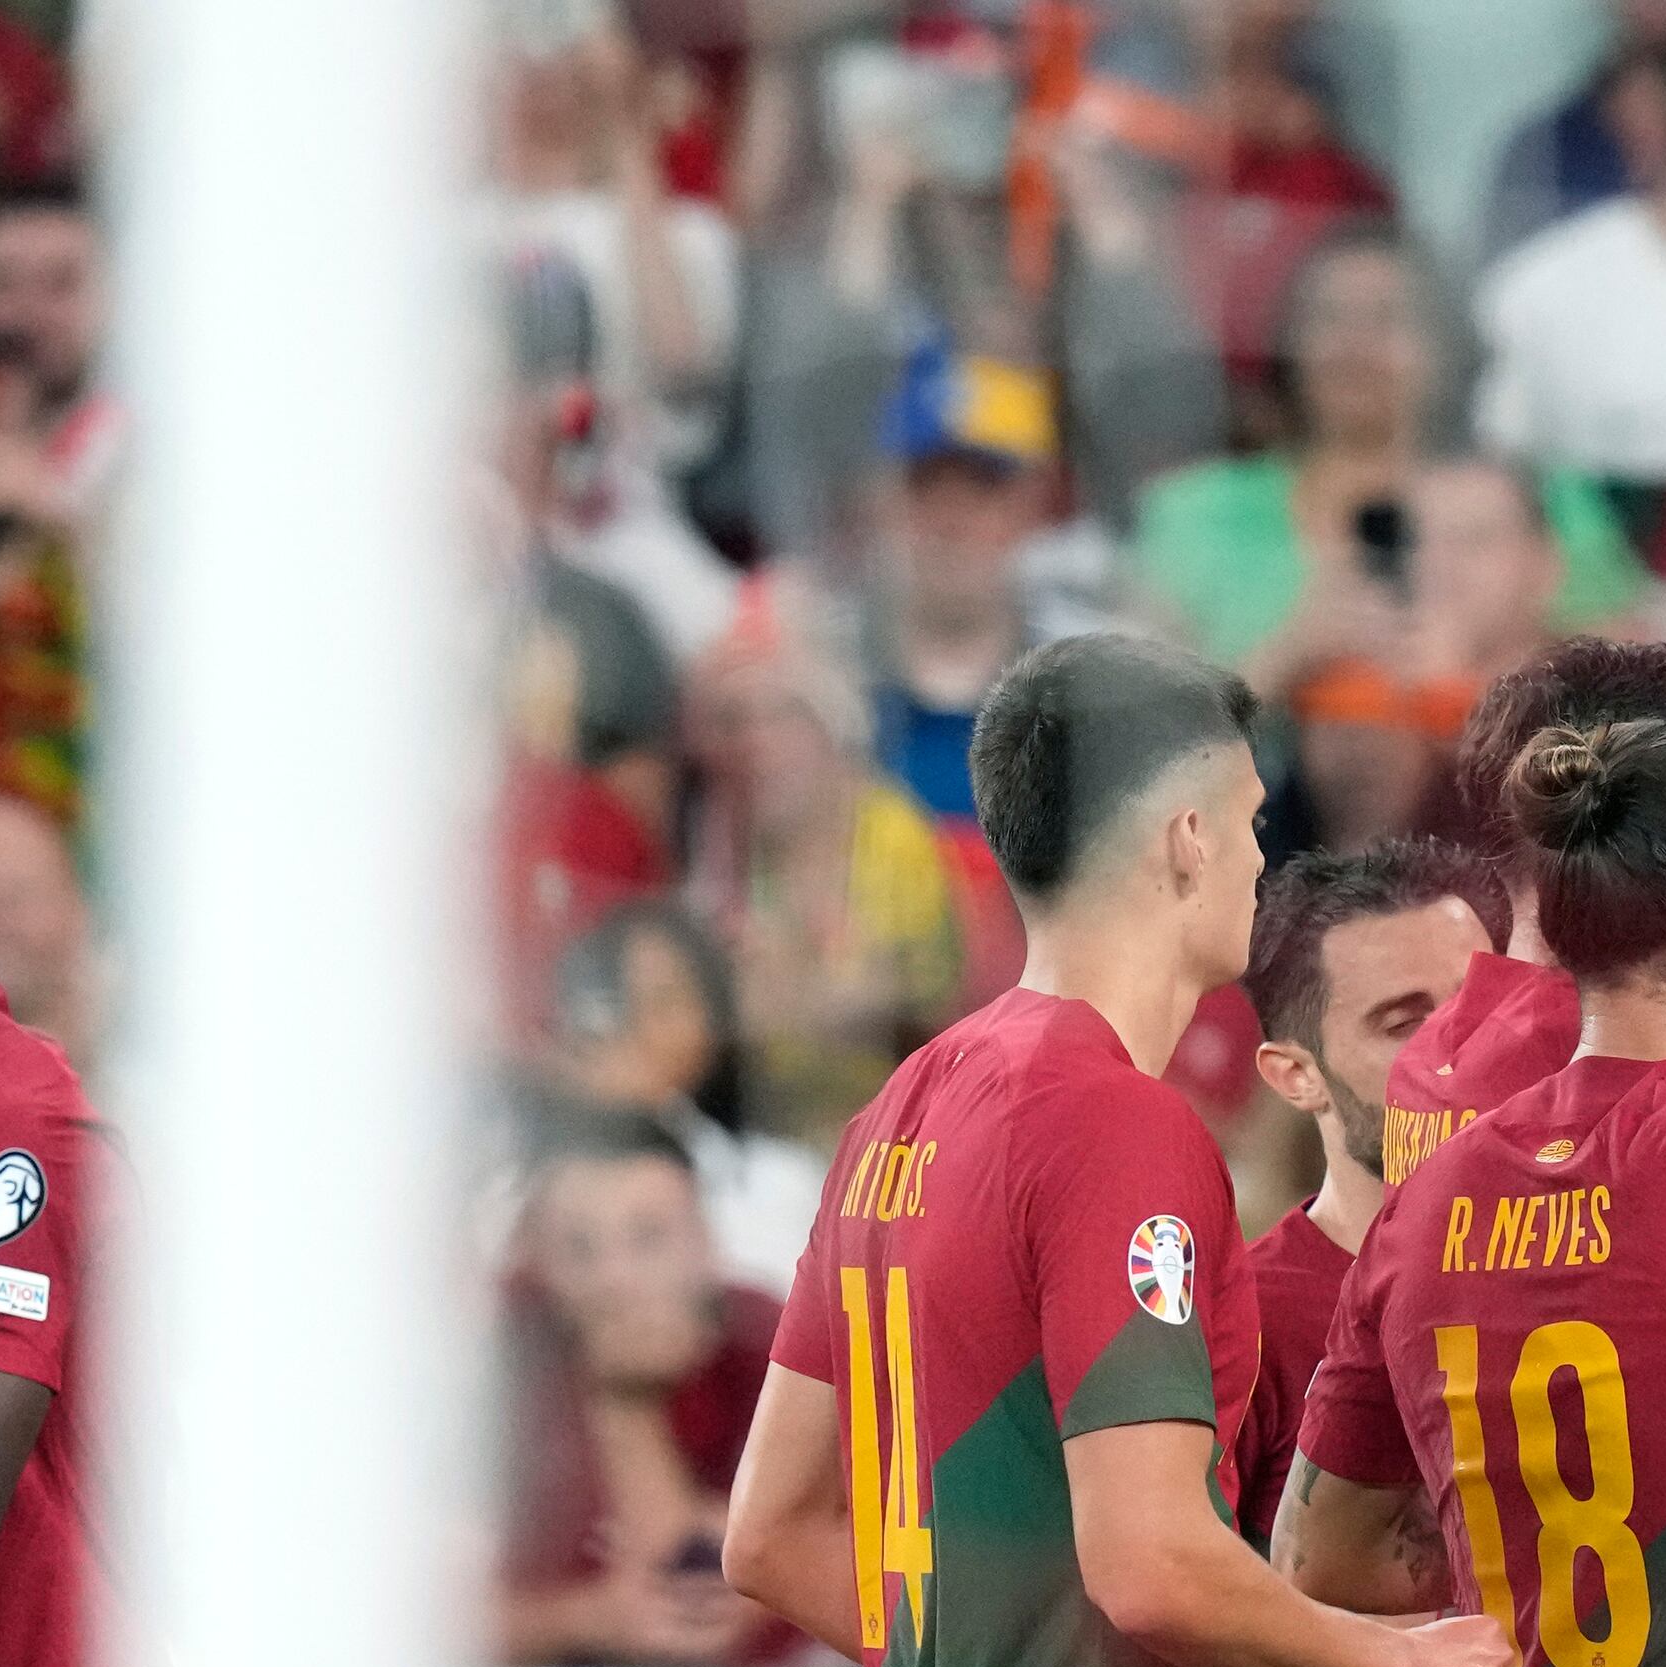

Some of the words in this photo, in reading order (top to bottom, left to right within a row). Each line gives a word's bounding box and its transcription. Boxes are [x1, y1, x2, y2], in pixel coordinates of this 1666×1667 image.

[1441, 1196, 1477, 1272] R.
[1484, 1184, 1611, 1271] NEVES
[839, 1266, 934, 1649] 14
